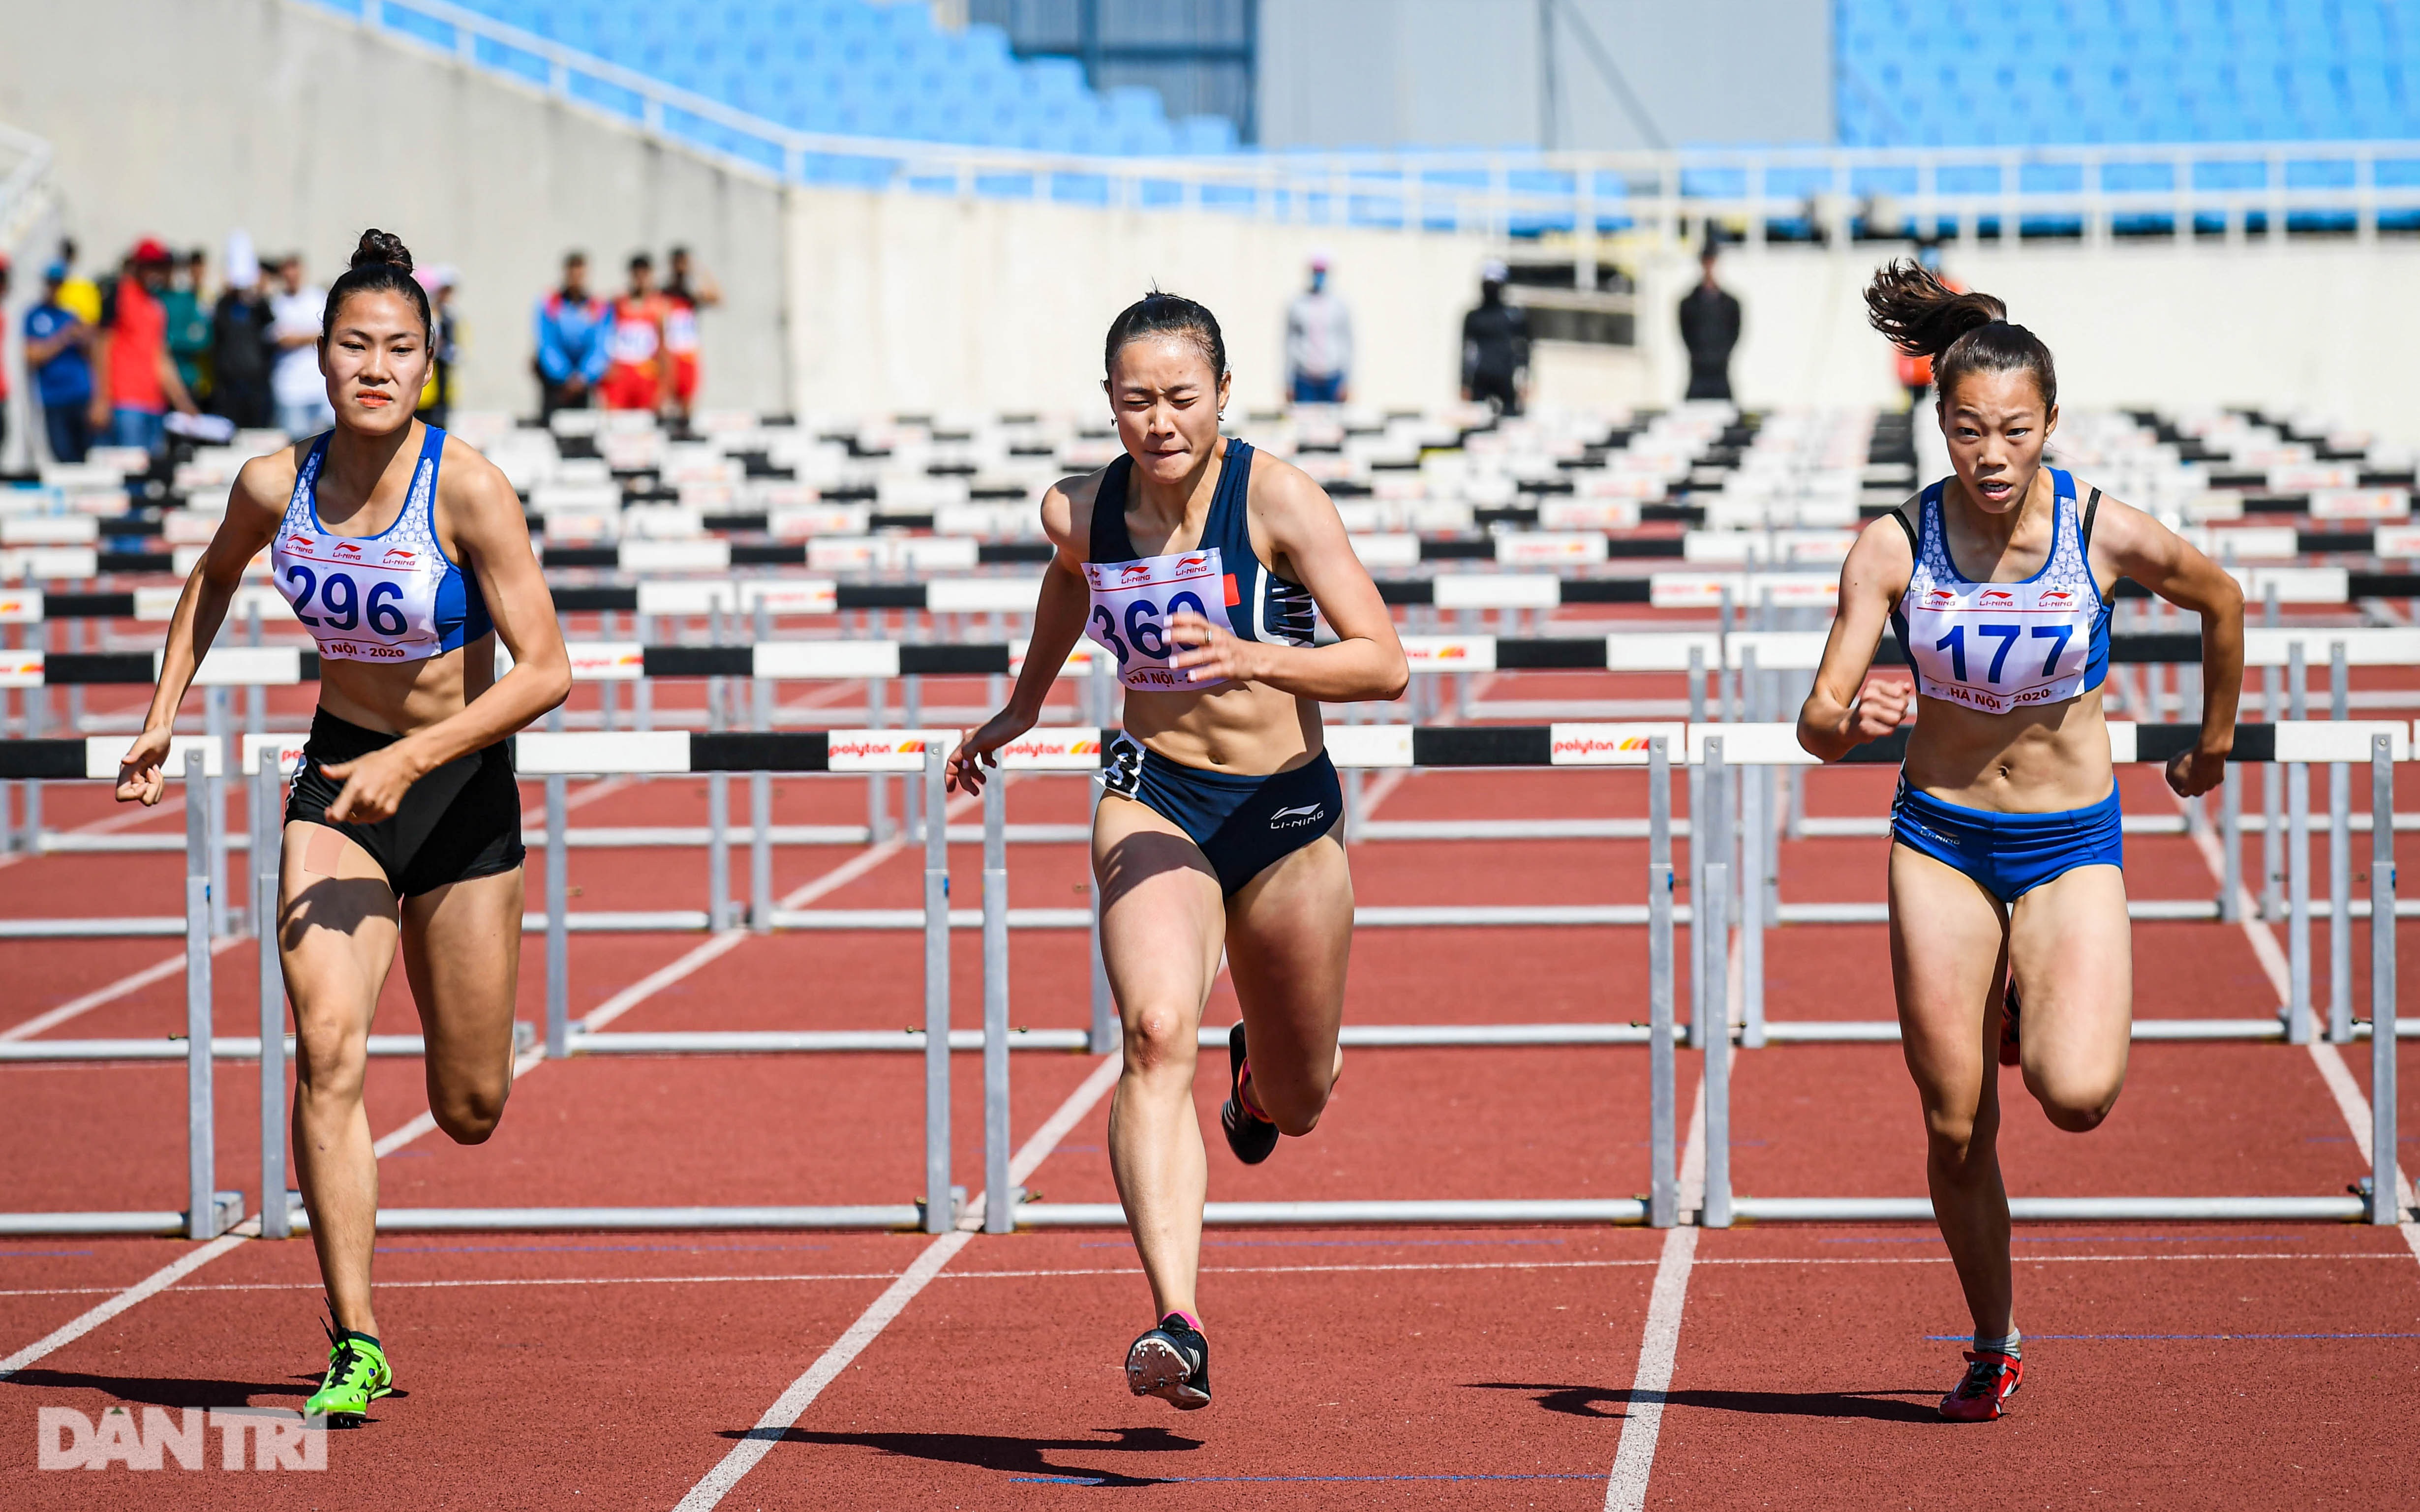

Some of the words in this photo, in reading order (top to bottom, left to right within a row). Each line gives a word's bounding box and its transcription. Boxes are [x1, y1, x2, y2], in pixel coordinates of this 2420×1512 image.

[286, 543, 313, 554] LI-NING
[333, 551, 362, 560] LI-NING
[1121, 575, 1151, 584] LI-NING
[1175, 566, 1208, 576] LI-NING
[286, 565, 408, 635] 296
[331, 642, 358, 657] NỘI
[369, 647, 405, 657] 2020
[1936, 624, 2073, 684] 177
[1150, 671, 1175, 688] NỘI
[1950, 687, 1971, 701] HÀ
[1975, 694, 2001, 710] NỘI
[2013, 689, 2050, 703] 2020
[828, 741, 891, 758] polytan
[1004, 742, 1064, 758] polytan
[1553, 737, 1614, 755] polytan
[1270, 810, 1324, 830] LI-NING
